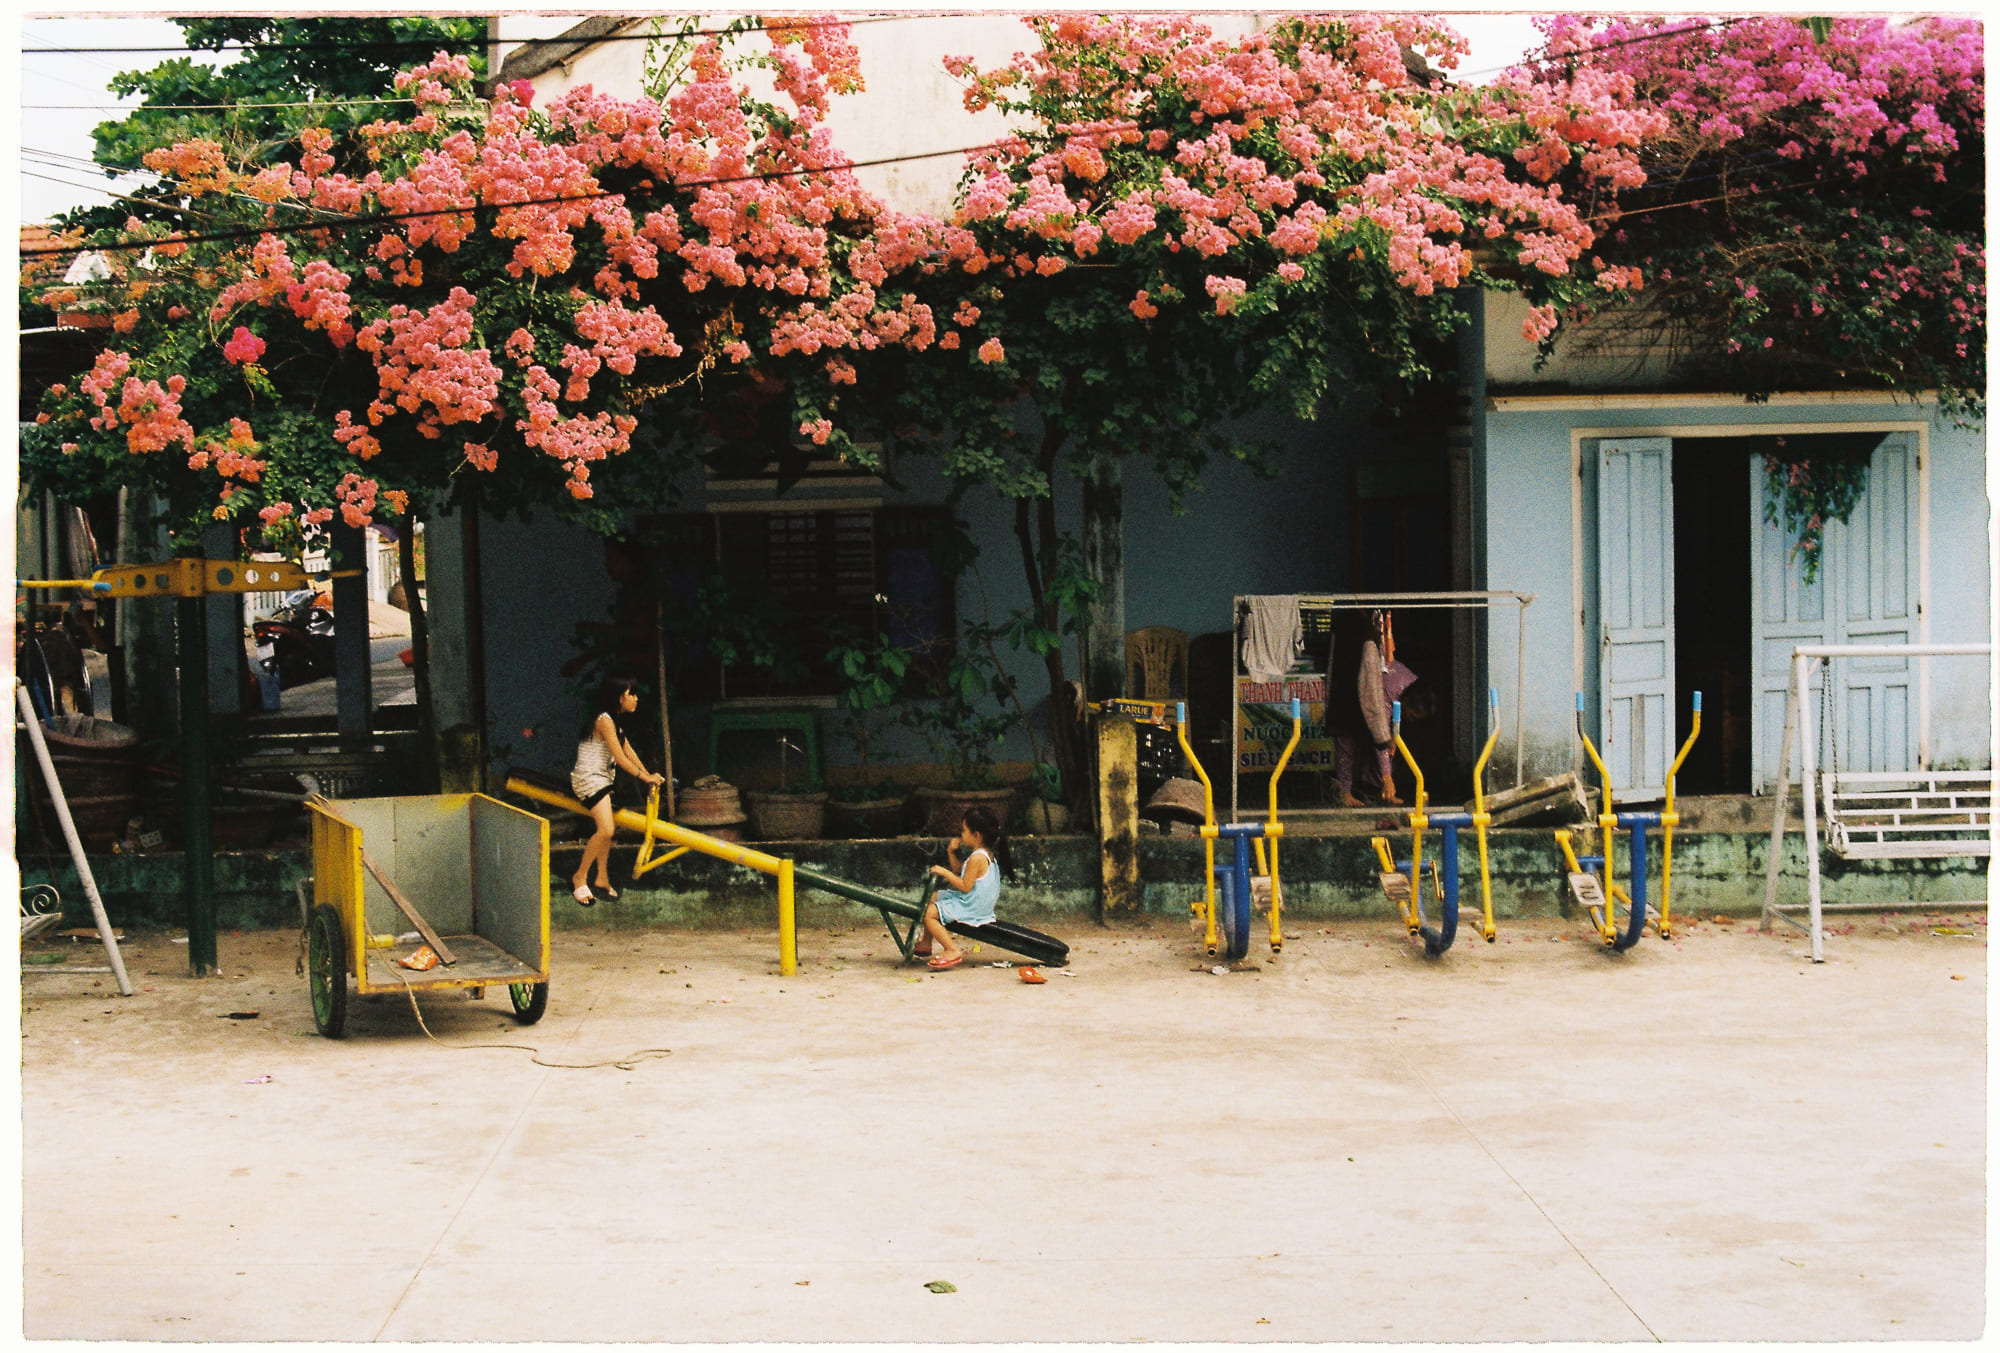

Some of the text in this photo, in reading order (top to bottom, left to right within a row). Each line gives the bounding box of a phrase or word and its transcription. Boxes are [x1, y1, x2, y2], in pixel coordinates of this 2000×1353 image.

[1240, 682, 1283, 703] THANH
[1119, 704, 1150, 716] LARUE
[1240, 748, 1282, 767] SIÊU
